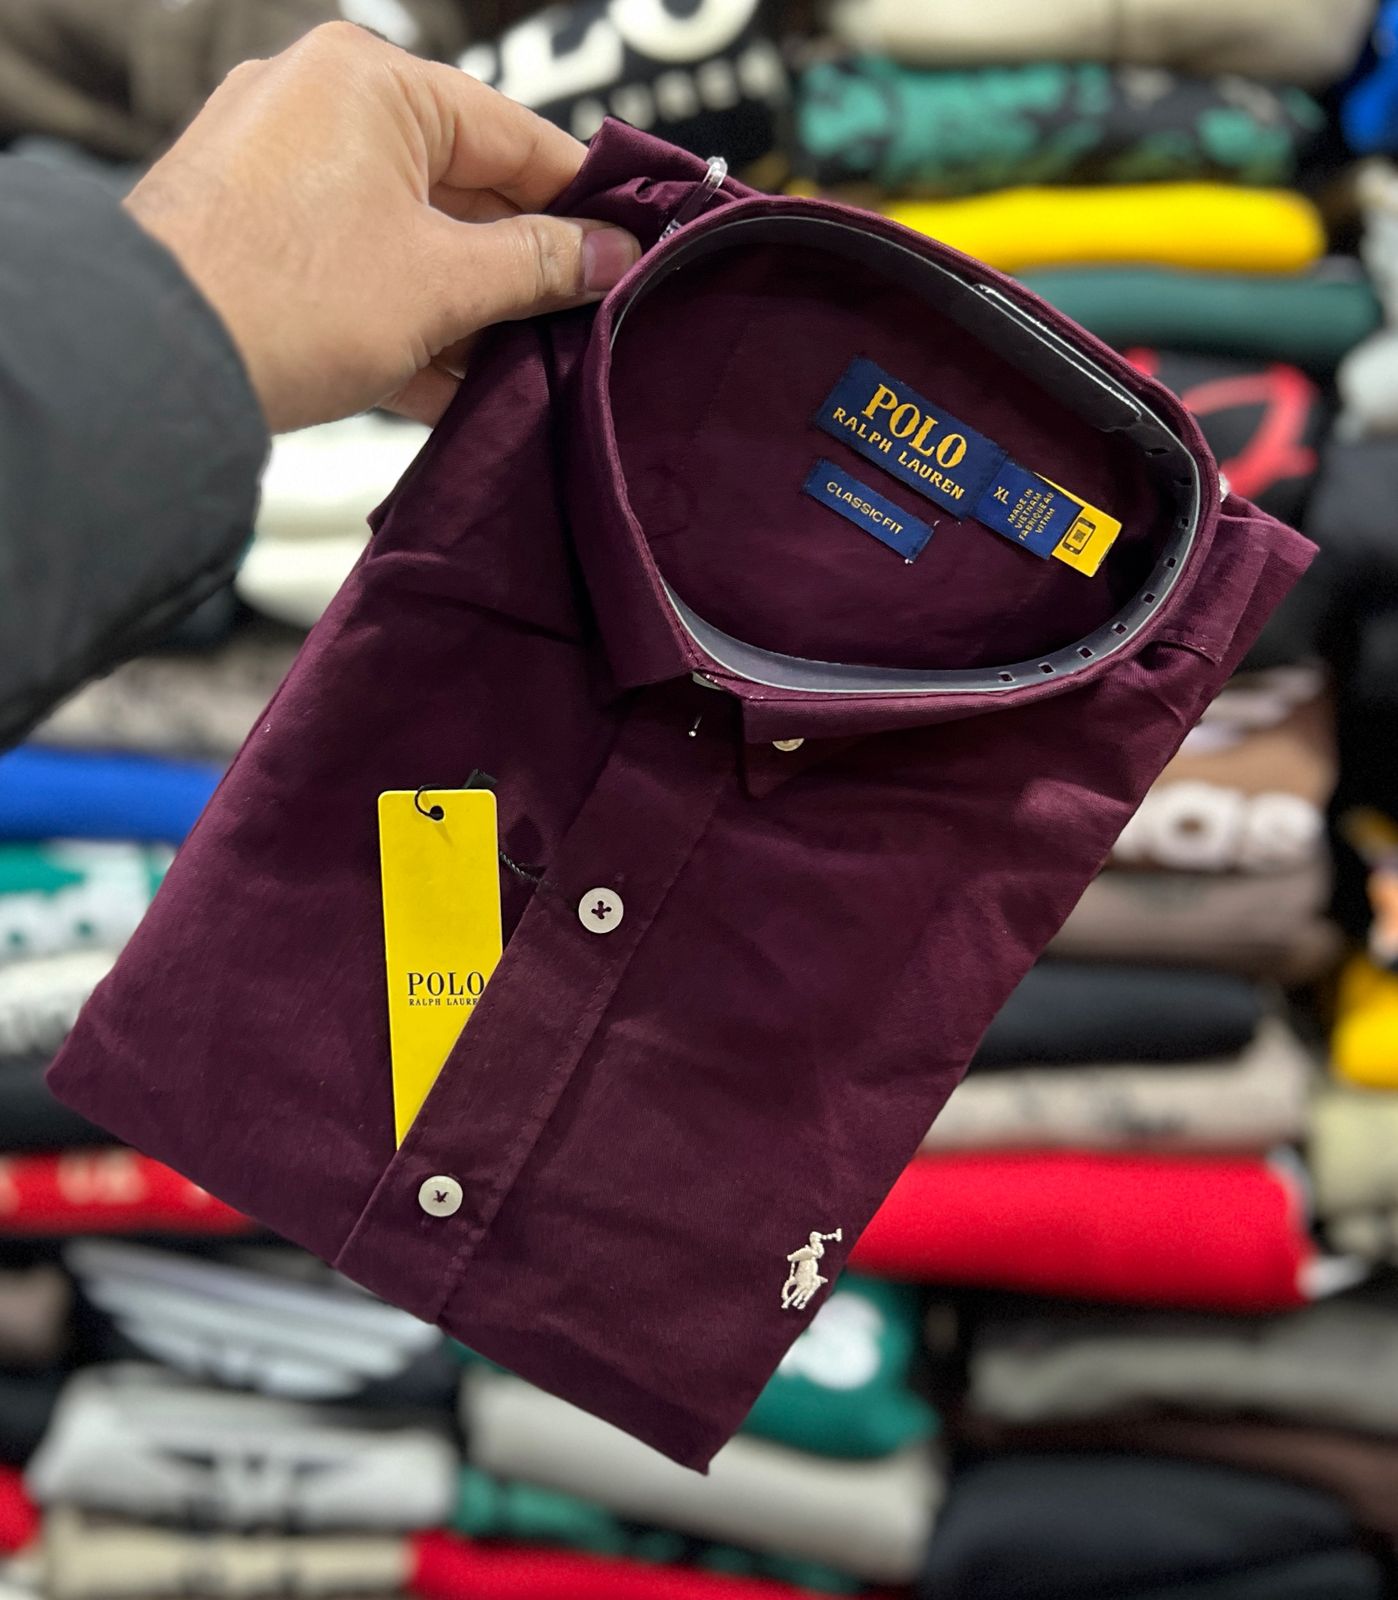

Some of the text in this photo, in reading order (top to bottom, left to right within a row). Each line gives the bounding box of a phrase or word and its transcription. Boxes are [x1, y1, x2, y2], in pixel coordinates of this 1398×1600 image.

[861, 383, 967, 468] POLO
[833, 407, 965, 500] RALPH LAUREN
[826, 481, 903, 534] CLASSIC FIT
[993, 486, 1009, 504] XL
[1007, 488, 1033, 523] MADE IN
[1014, 492, 1042, 529] VIETNAM
[407, 971, 485, 996] POLO
[409, 998, 478, 1006] RALPH LAURE
